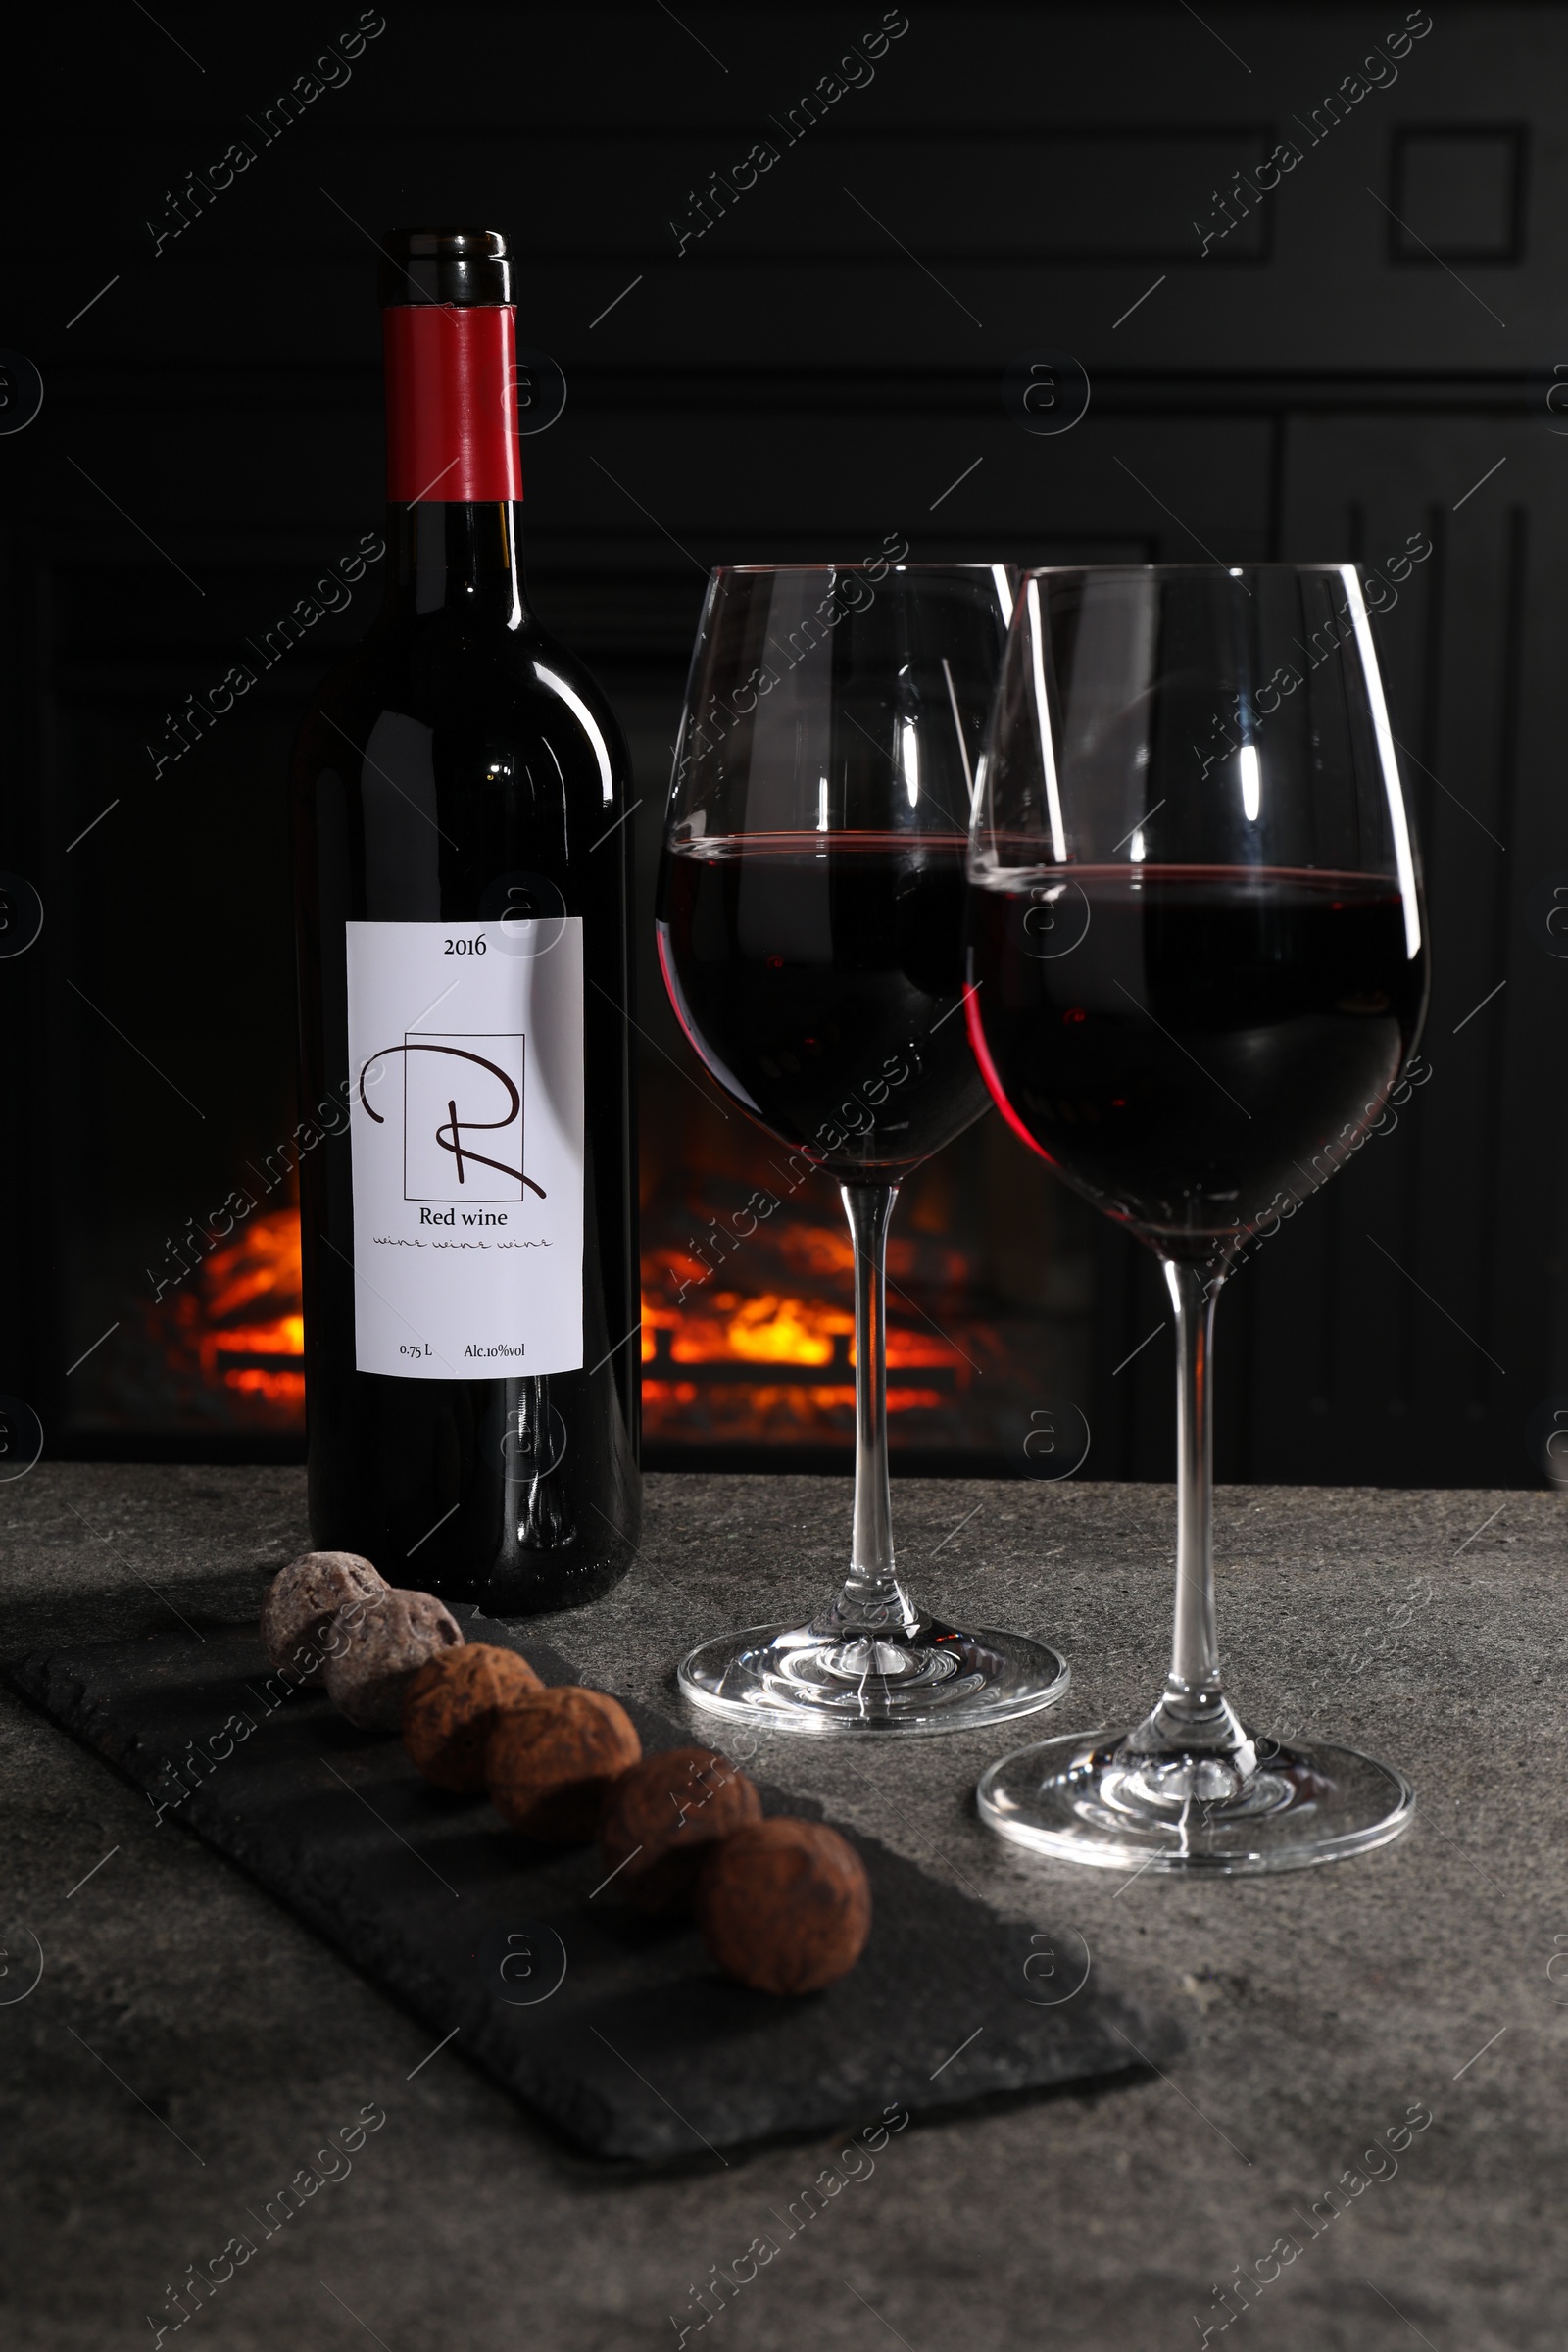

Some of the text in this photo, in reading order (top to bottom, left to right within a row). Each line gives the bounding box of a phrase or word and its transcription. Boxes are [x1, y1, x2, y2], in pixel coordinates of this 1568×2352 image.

[443, 932, 488, 956] 2016
[359, 1044, 547, 1200] R
[419, 1206, 509, 1226] Red wine
[372, 1235, 554, 1250] wine wine wine
[399, 1343, 525, 1359] 0.75 L Alc.10%vol
